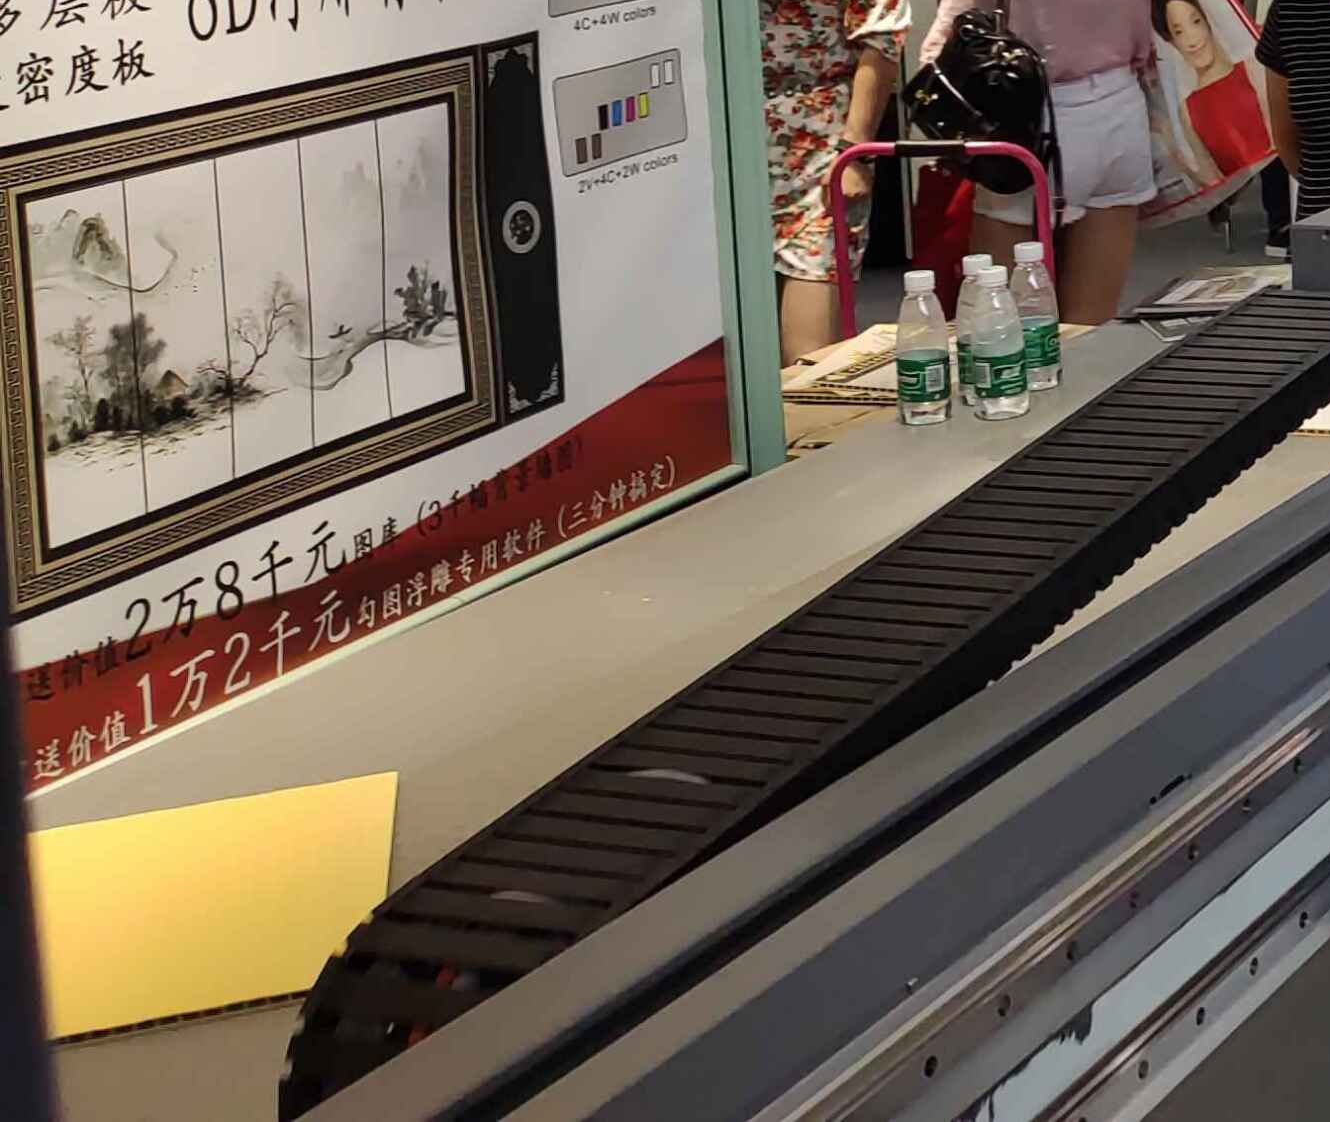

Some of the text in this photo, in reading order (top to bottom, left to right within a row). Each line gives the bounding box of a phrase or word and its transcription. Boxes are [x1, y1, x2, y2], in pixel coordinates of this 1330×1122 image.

[573, 5, 657, 31] 4C+4W colors
[0, 38, 156, 111] 密度板
[642, 154, 679, 172] colors
